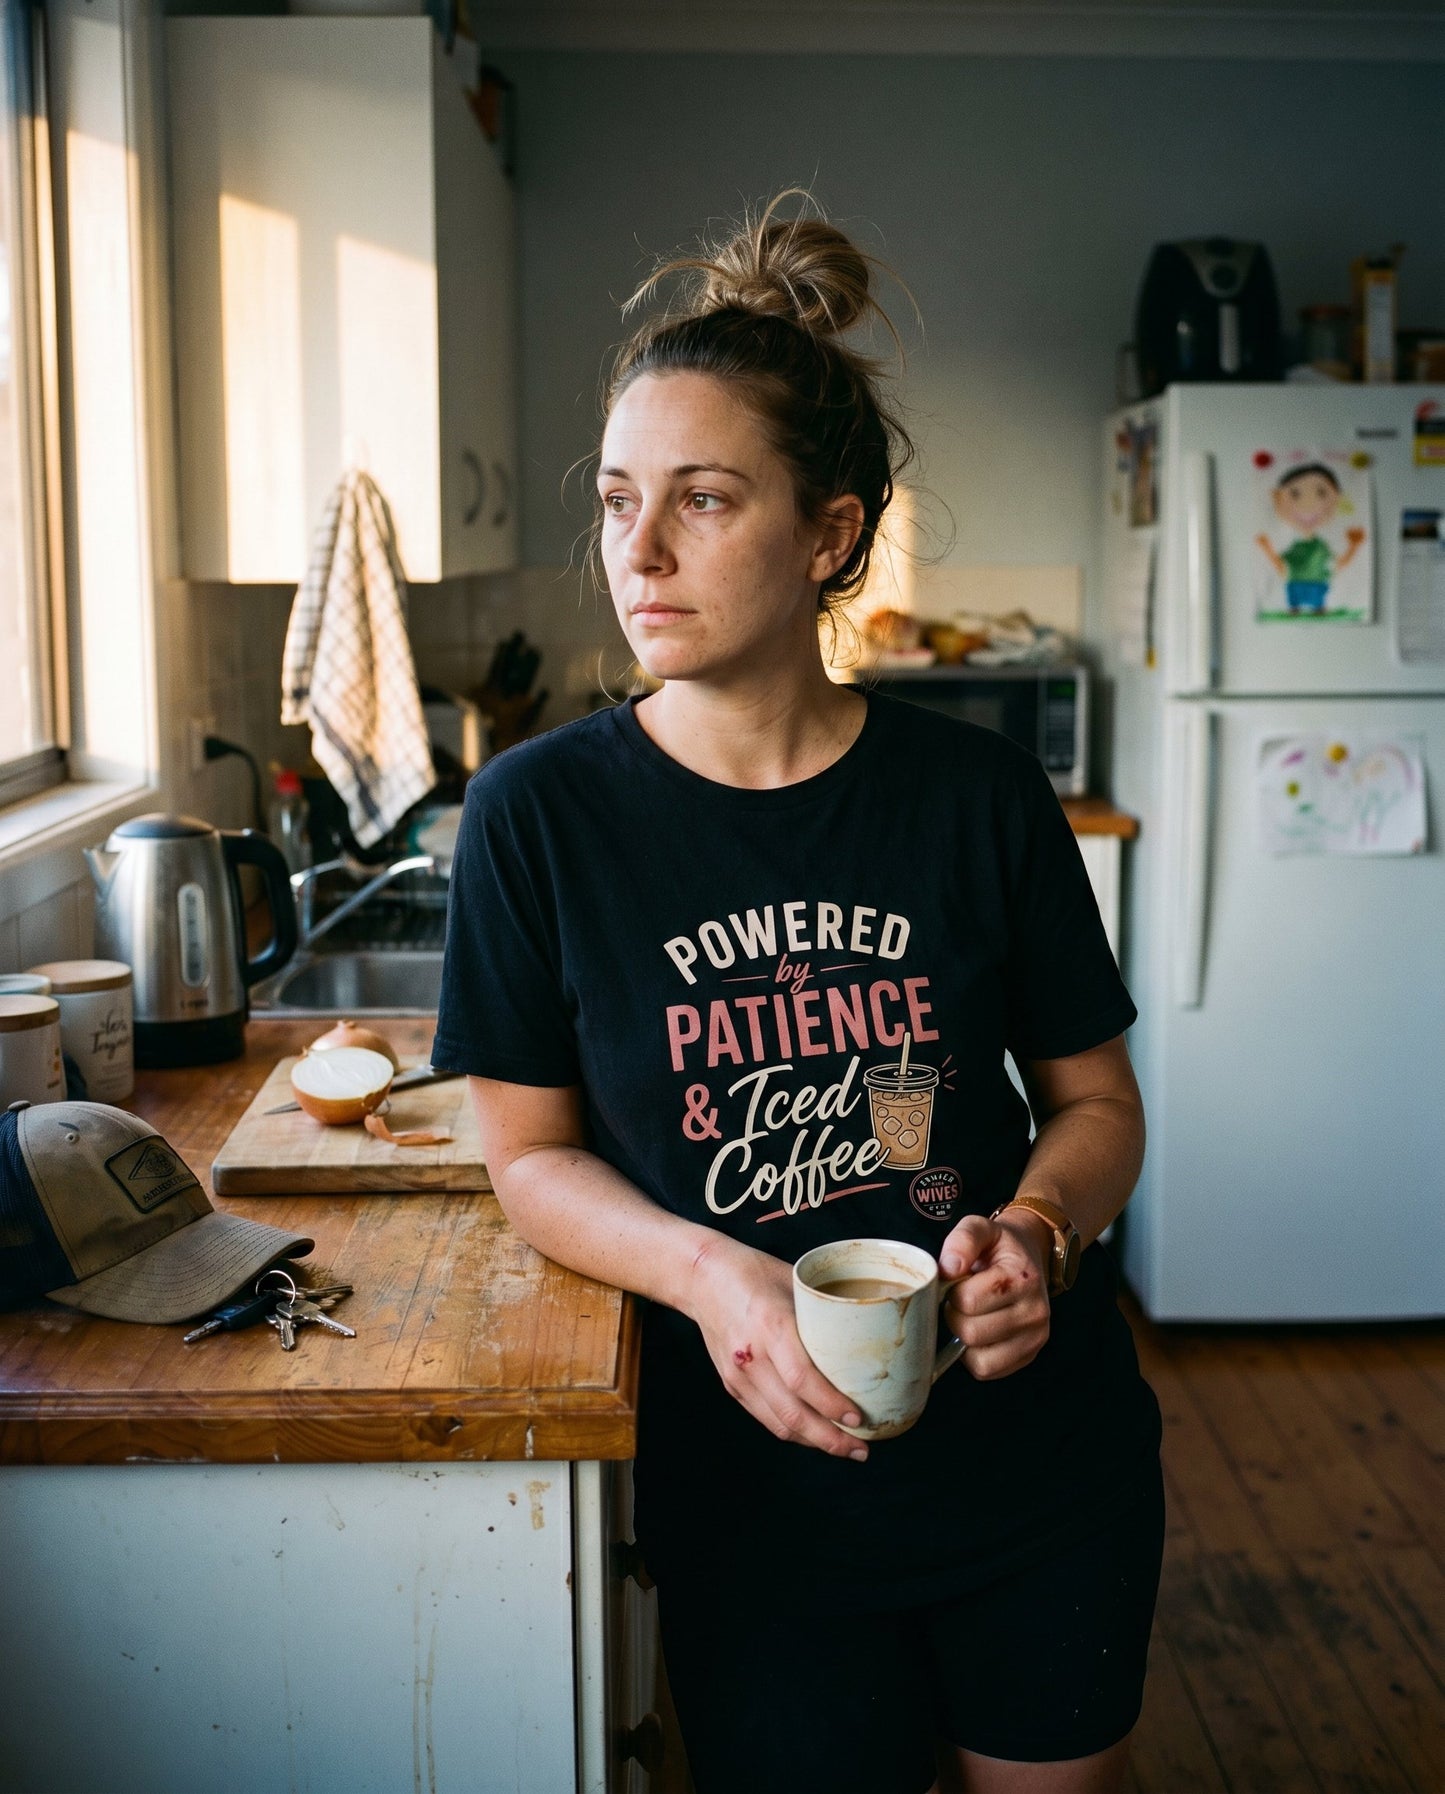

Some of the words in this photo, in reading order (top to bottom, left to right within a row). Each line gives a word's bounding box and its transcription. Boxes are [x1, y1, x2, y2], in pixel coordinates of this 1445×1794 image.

[663, 901, 911, 985] POWERED
[775, 953, 814, 993] by
[666, 976, 939, 1072] PATIENCE
[682, 1083, 722, 1141] &
[727, 1055, 862, 1140] Iced
[704, 1124, 890, 1215] Coffee
[916, 1184, 958, 1203] WIVES
